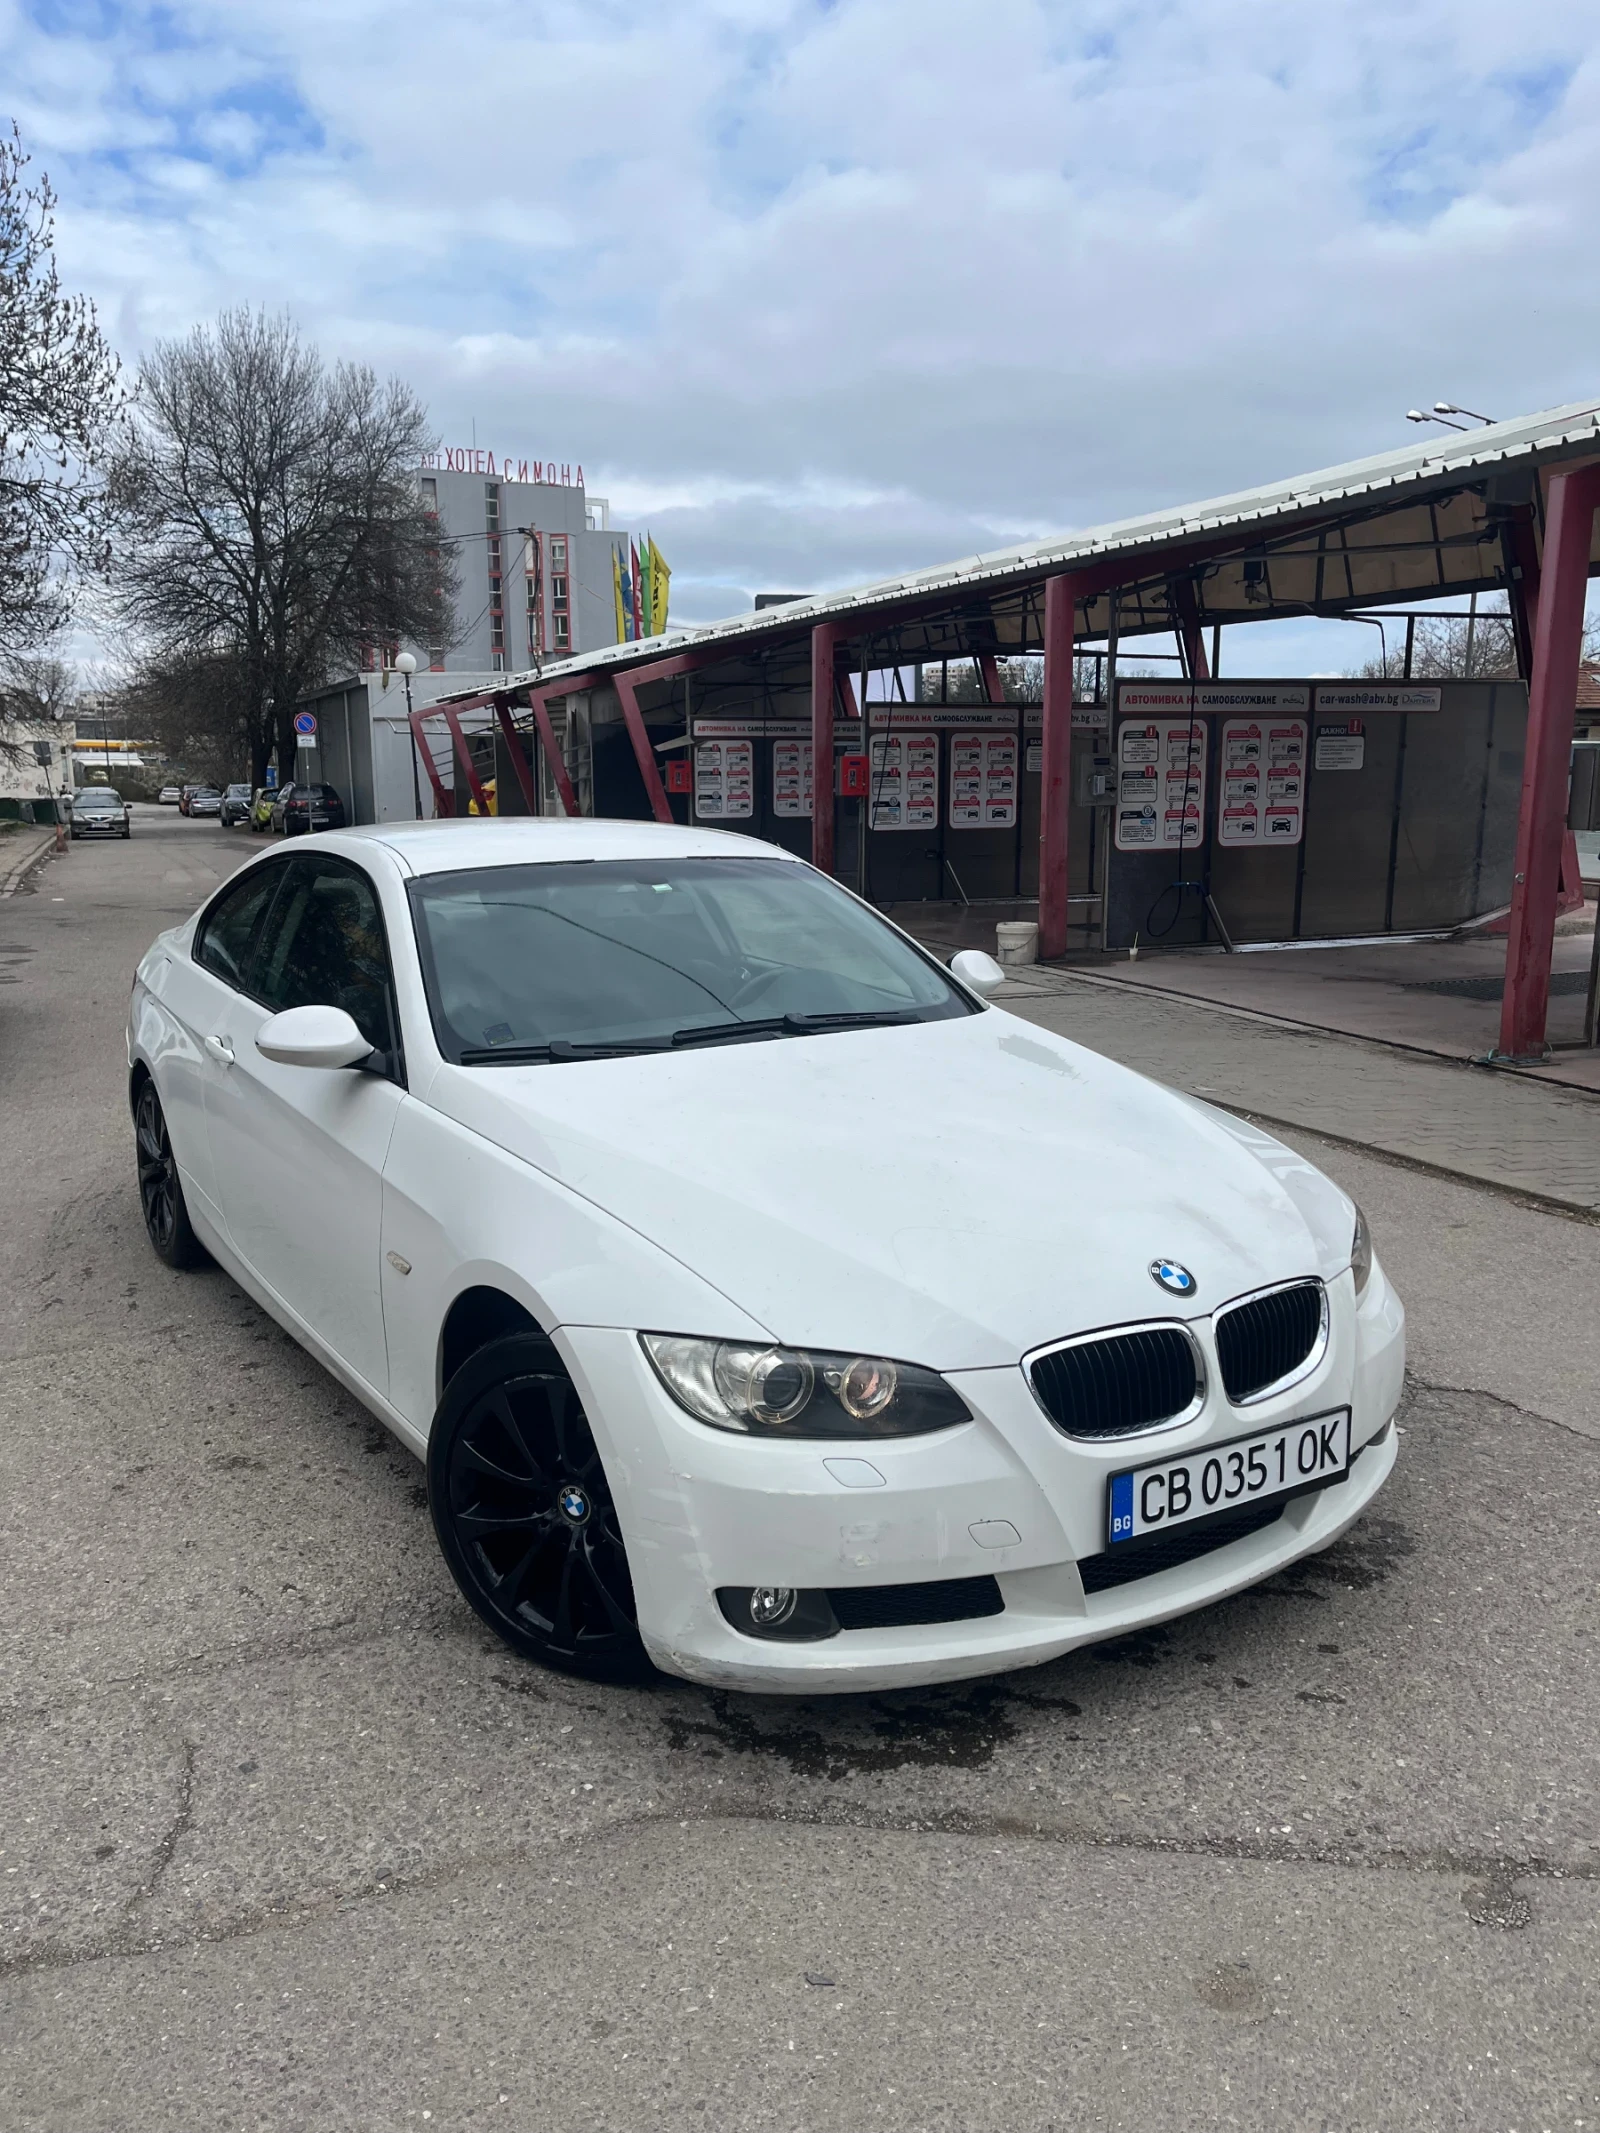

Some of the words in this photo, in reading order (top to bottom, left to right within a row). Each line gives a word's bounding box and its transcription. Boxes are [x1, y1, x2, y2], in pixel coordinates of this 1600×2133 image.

[445, 447, 495, 475] ХОТЕЛ
[504, 458, 584, 488] СИМОНА
[1125, 695, 1184, 704] АВТОМИВКА
[1186, 695, 1199, 704] НА
[1202, 695, 1277, 705] САМООБСЛУЖВАНЕ
[1320, 693, 1399, 706] car-wash@abv.bg
[873, 714, 919, 722] АВТОМИВКА
[934, 715, 993, 723] САМООБСЛУЖВАНЕ
[1320, 727, 1347, 735] ВАЖНО!
[1141, 1466, 1192, 1524] CB
[1201, 1437, 1286, 1505] 0351
[1297, 1420, 1340, 1475] OK
[1113, 1514, 1131, 1533] BG
